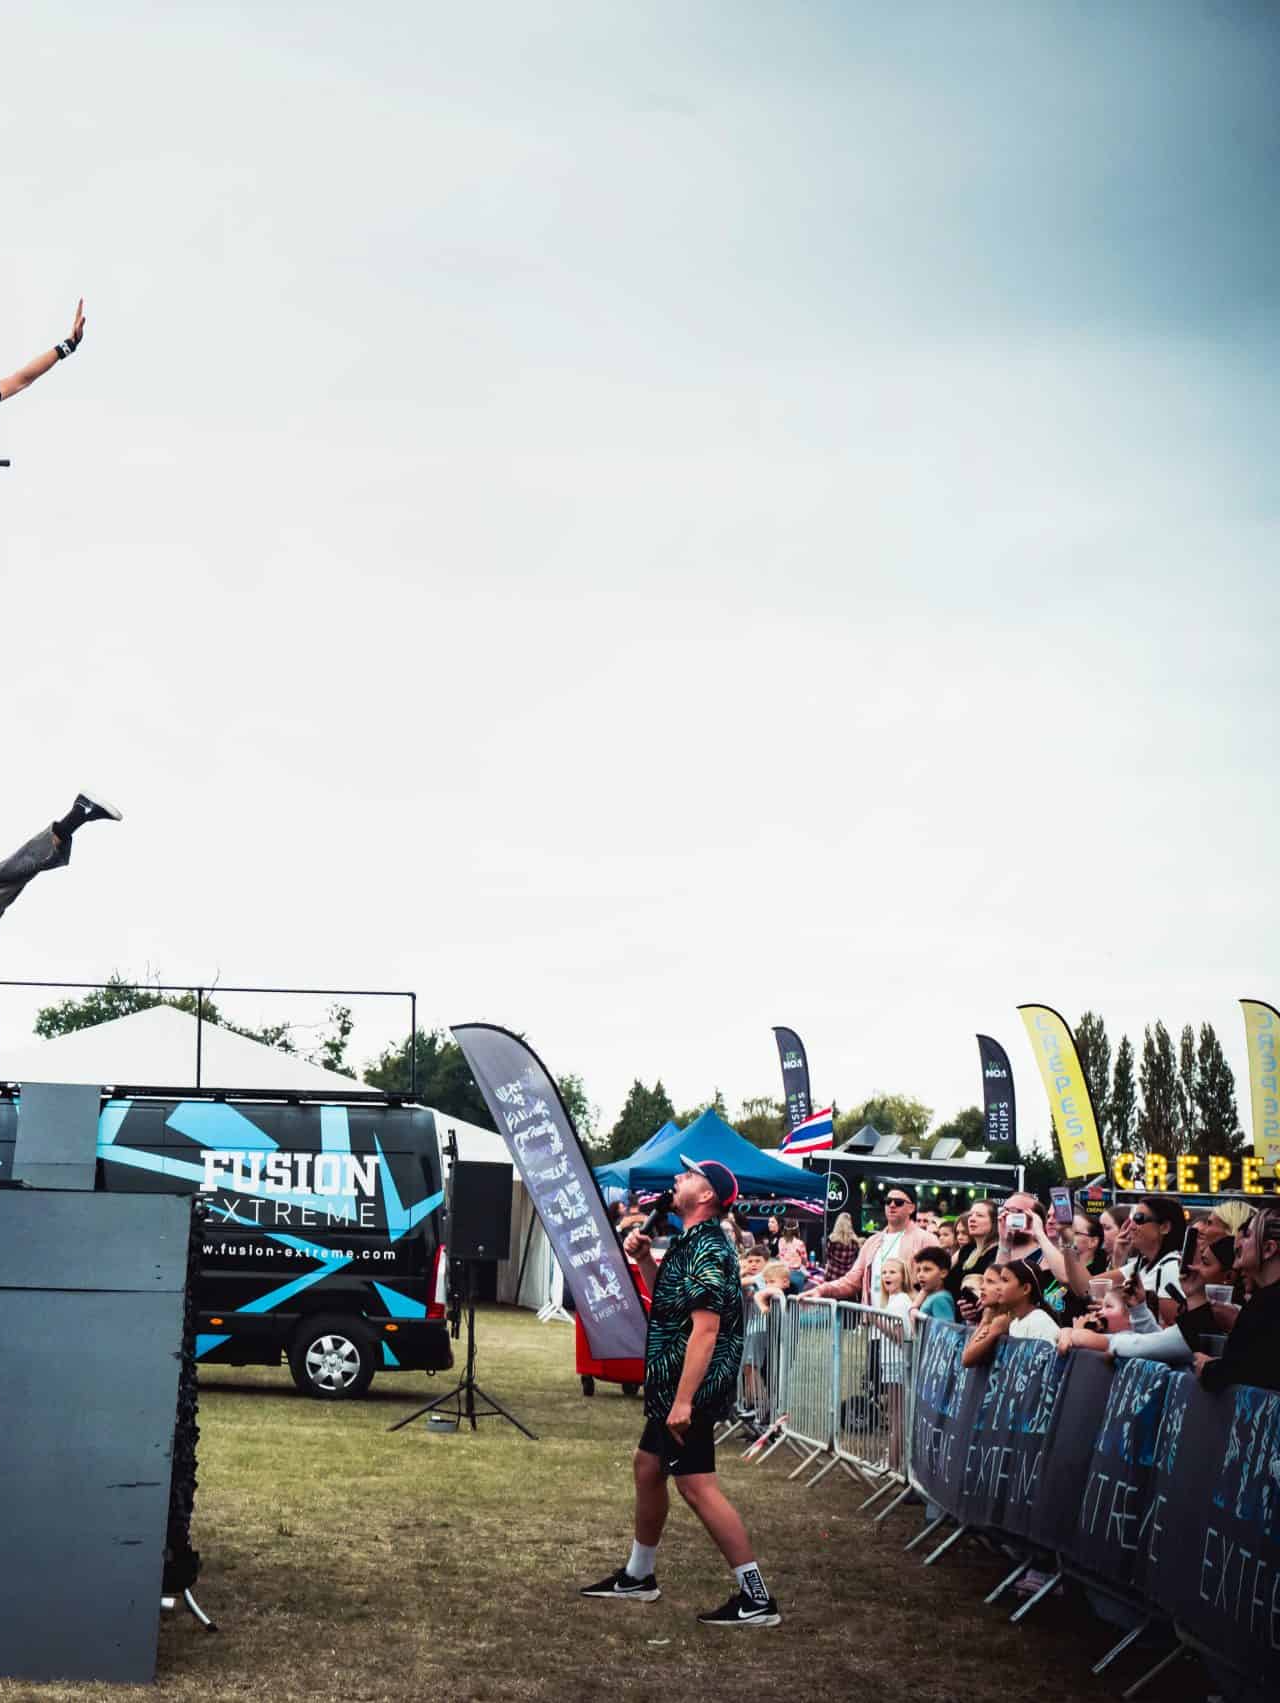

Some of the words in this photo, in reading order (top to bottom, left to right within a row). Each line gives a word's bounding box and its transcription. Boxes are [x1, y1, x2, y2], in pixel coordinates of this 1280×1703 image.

[789, 1104, 801, 1126] ISH
[989, 1112, 999, 1141] FISH
[999, 1102, 1009, 1141] CHIPS
[199, 1150, 380, 1197] FUSION
